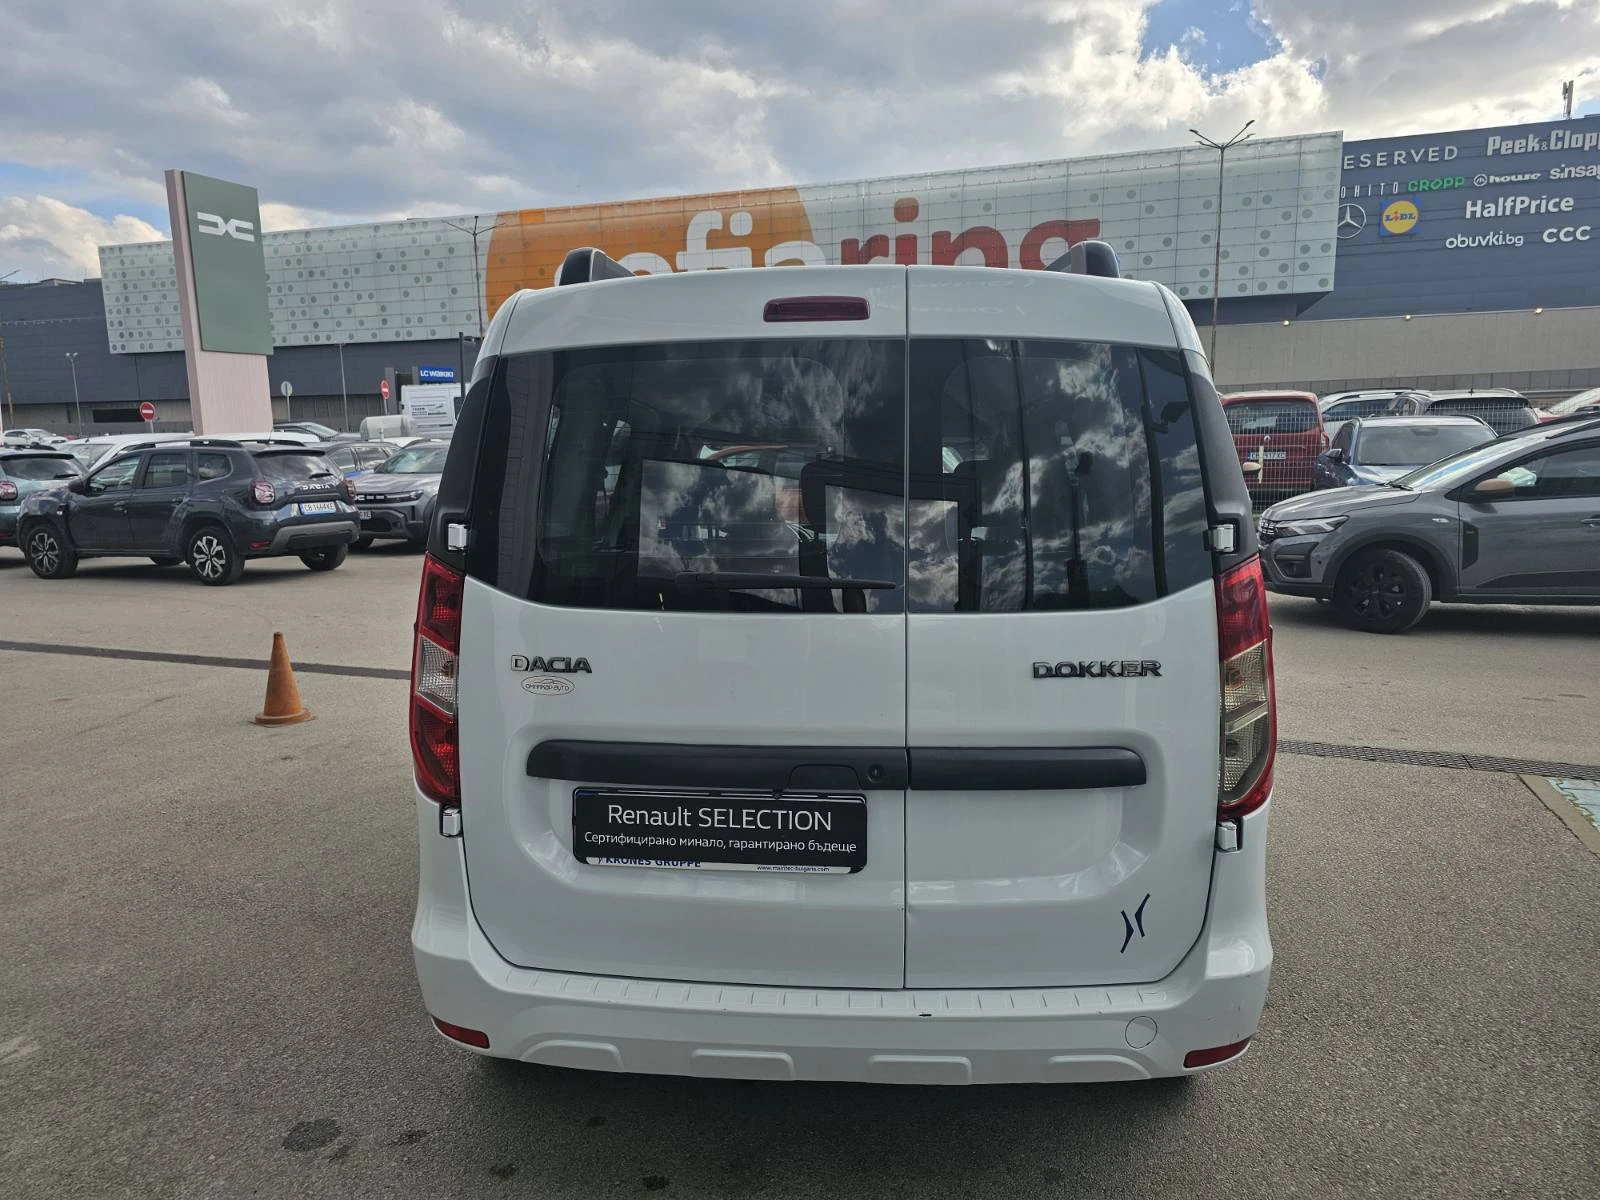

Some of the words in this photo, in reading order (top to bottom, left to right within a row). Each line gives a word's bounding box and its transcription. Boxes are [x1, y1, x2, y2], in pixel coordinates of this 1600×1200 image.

[1343, 145, 1459, 170] ESERVED
[1340, 181, 1399, 199] OHITO
[1465, 195, 1574, 219] HalfPrice
[1445, 230, 1524, 249] obuvki.bg
[1542, 225, 1592, 244] CCC
[511, 655, 592, 673] DACIA
[1033, 660, 1162, 678] DOKKER
[608, 805, 692, 827] Renault
[698, 807, 832, 831] SELECTION
[584, 831, 677, 847] Сертифицирано
[679, 836, 726, 849] минало,
[728, 839, 805, 852] гарантирано
[808, 840, 857, 853] бъдеще
